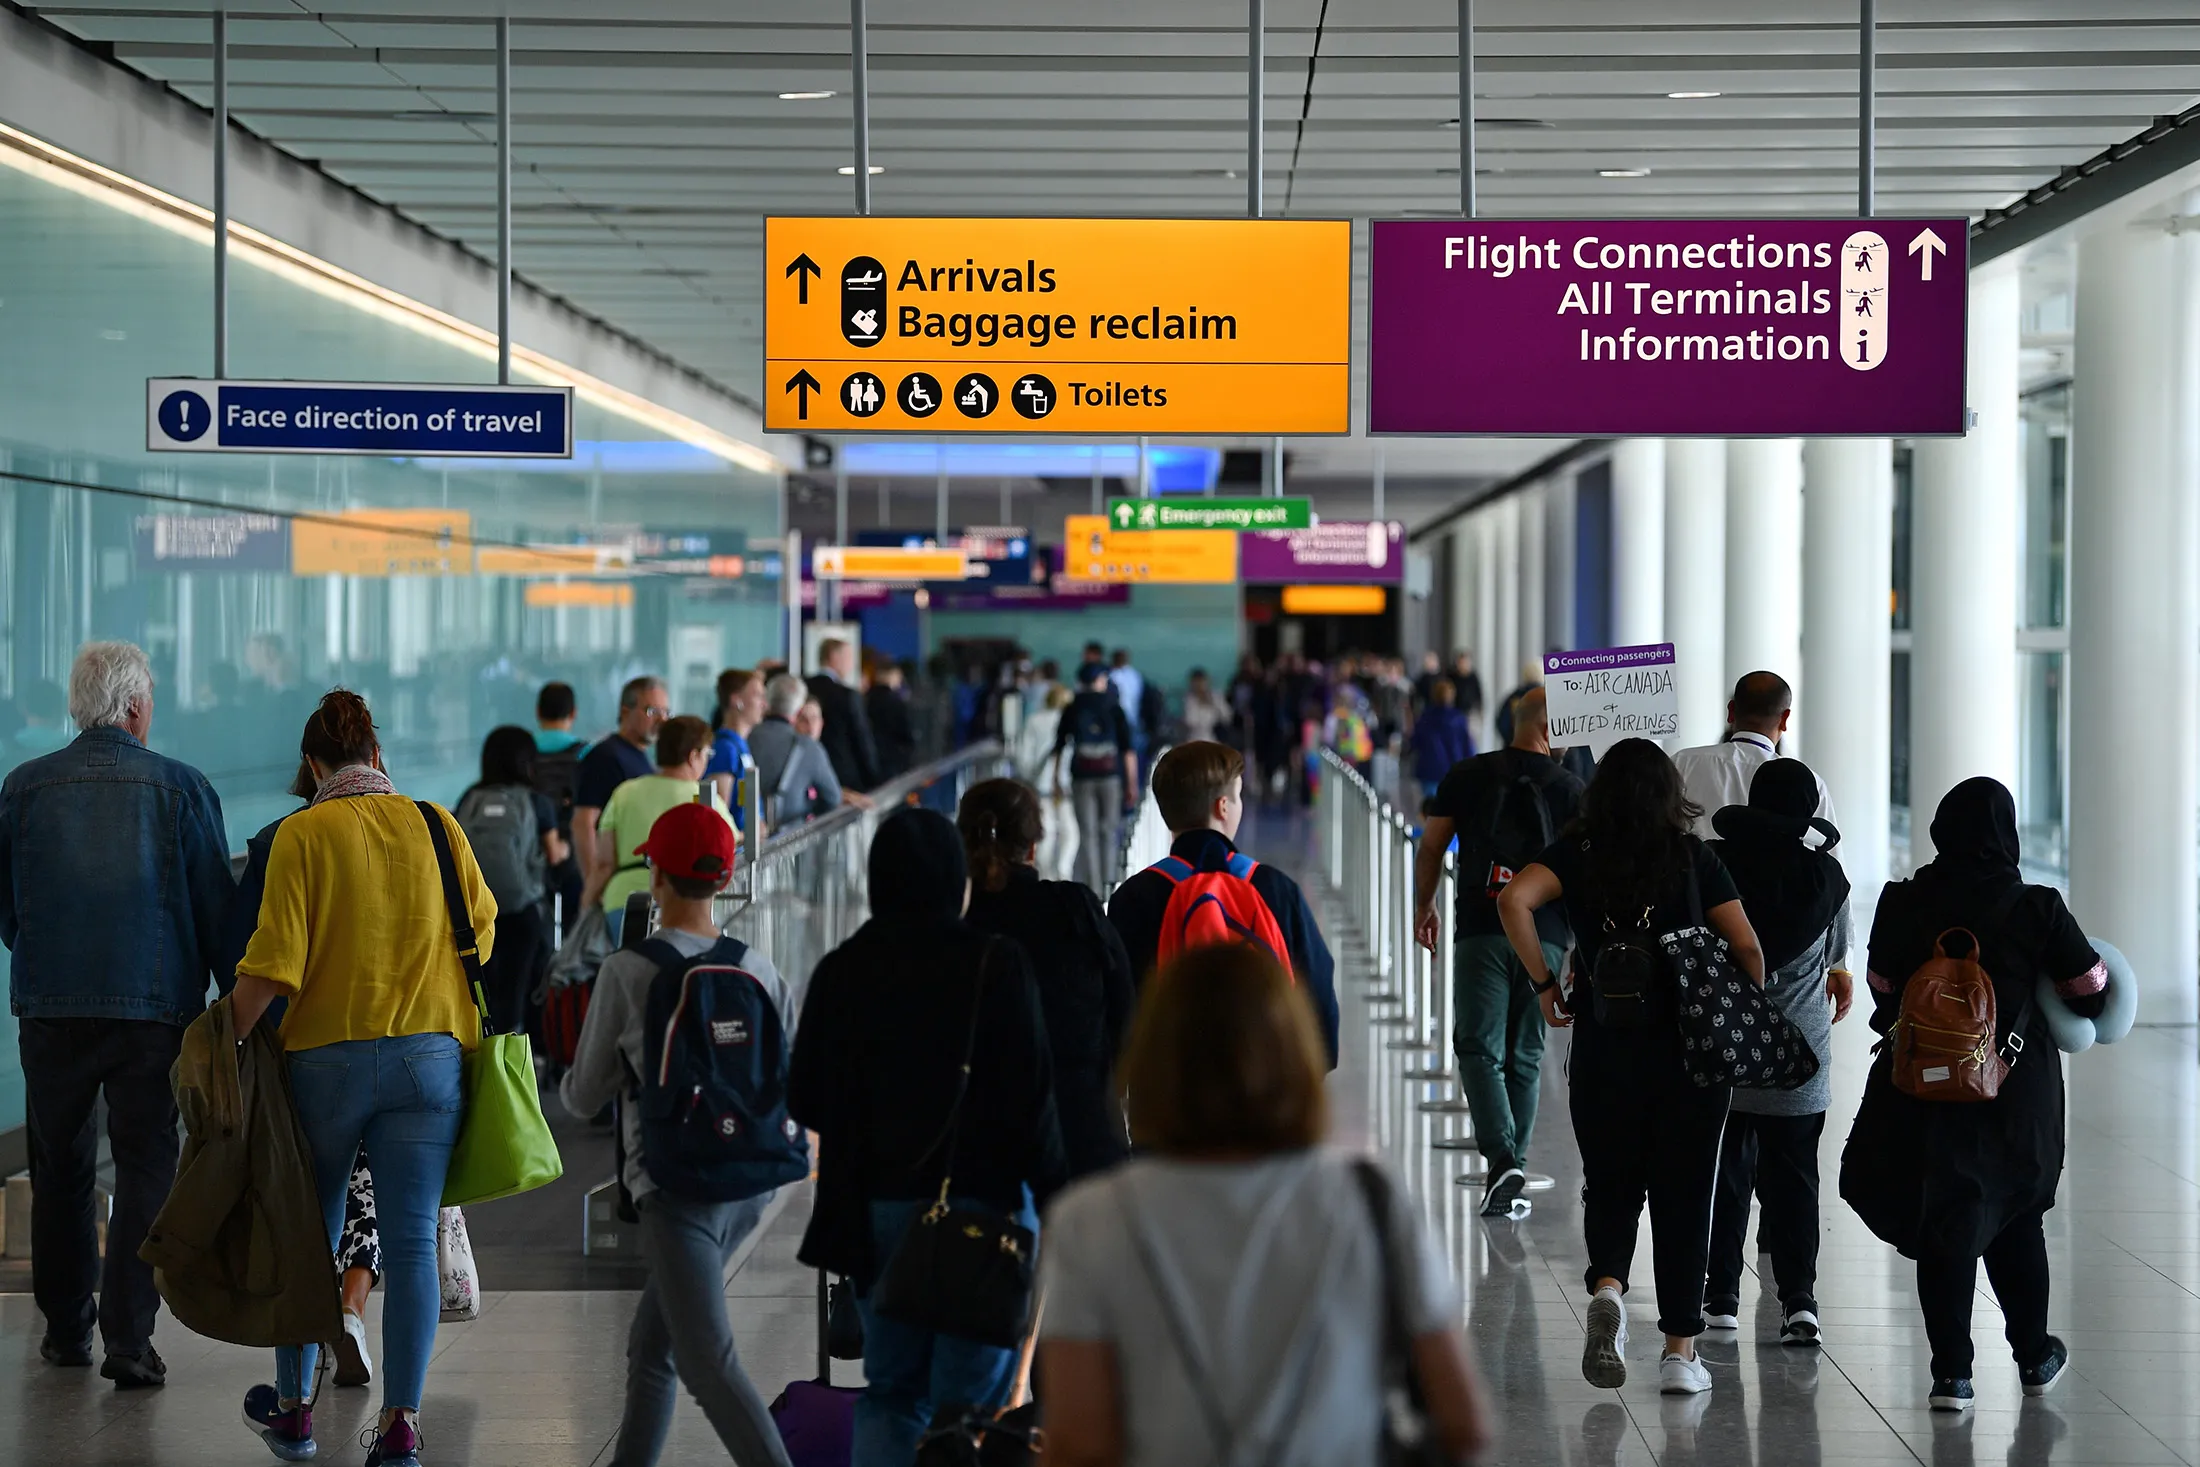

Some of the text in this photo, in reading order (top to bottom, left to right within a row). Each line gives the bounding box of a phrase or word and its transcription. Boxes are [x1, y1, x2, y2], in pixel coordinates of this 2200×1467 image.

[1445, 235, 1832, 277] Flight Connections
[896, 259, 1056, 293] Arrivals
[1556, 281, 1831, 315] All Terminals
[898, 305, 1237, 348] Baggage reclaim
[1580, 326, 1830, 361] Information
[1067, 382, 1168, 407] Toilets
[227, 405, 542, 433] Face direction of travel
[1160, 505, 1288, 527] Emergency exit
[1561, 650, 1671, 666] Connecting passengers
[1563, 680, 1582, 691] To:
[1551, 713, 1678, 737] UNITED AIRLINES
[721, 1117, 735, 1135] S
